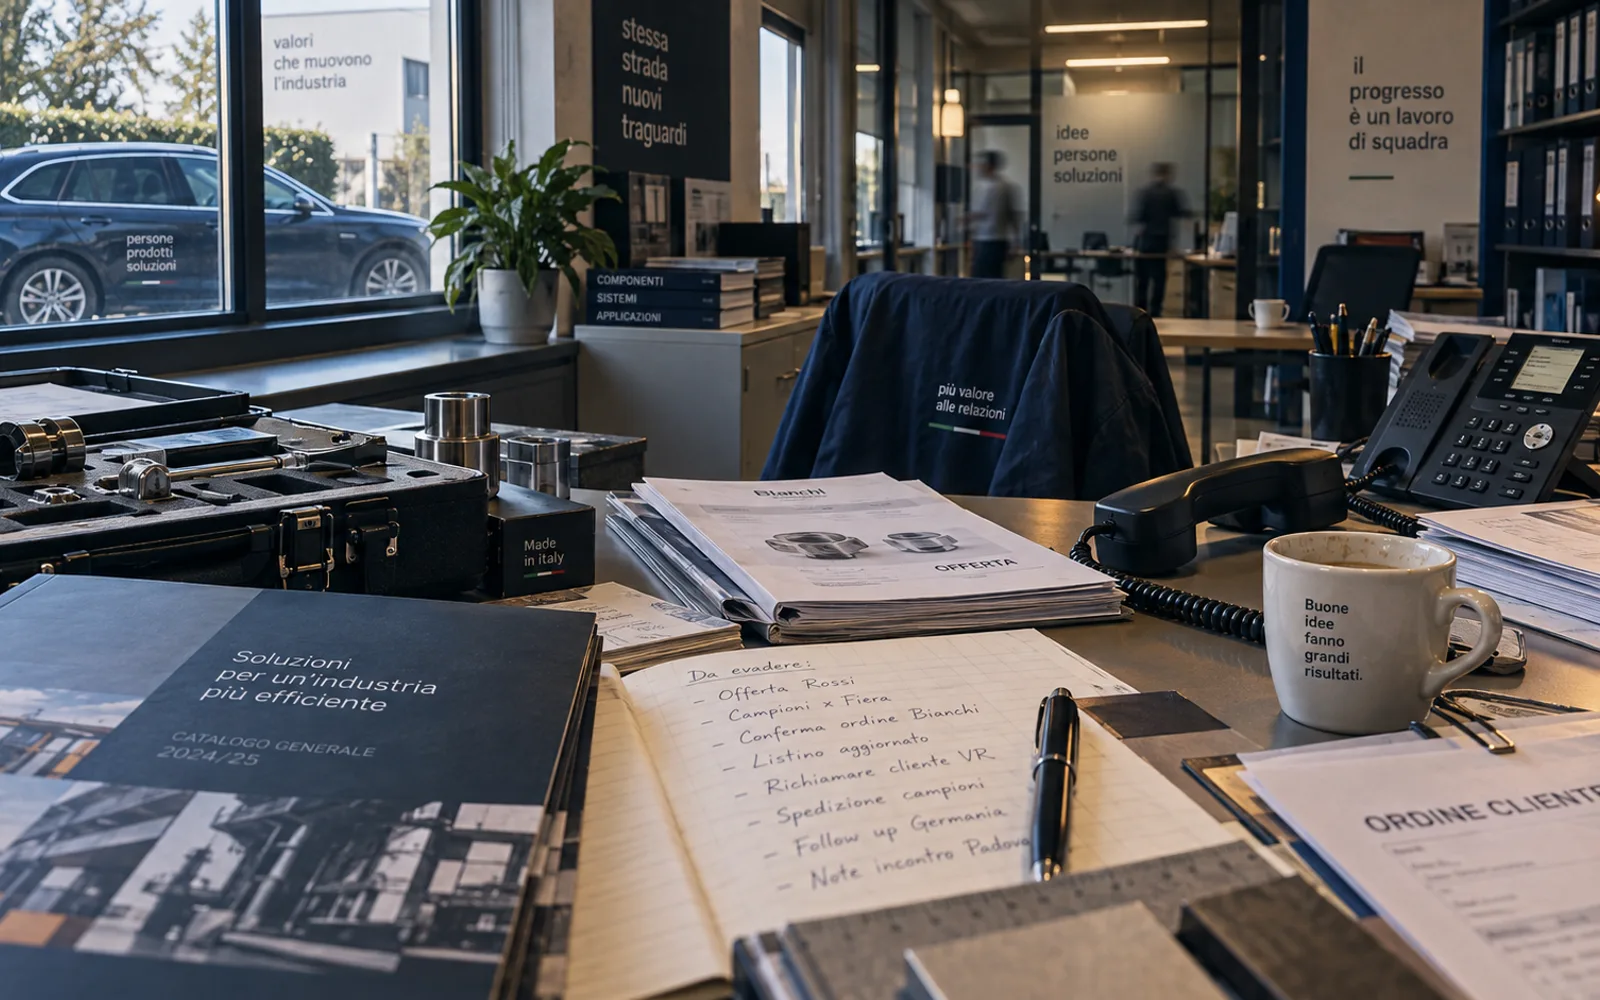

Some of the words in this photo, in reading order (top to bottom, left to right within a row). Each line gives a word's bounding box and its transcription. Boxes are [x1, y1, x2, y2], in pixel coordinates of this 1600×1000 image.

[273, 33, 314, 49] valori
[621, 17, 669, 52] stessa
[273, 55, 300, 71] che
[303, 53, 372, 69] muovono
[621, 50, 668, 82] strada
[1353, 56, 1364, 74] il
[273, 73, 347, 91] l'industria
[621, 84, 662, 111] nuovi
[1349, 85, 1444, 104] progresso
[1349, 107, 1360, 125] è
[1367, 110, 1390, 125] un
[1396, 107, 1454, 125] lavoro
[621, 114, 687, 147] traguardi
[1056, 125, 1089, 140] idee
[1349, 132, 1366, 150] di
[1372, 132, 1449, 154] squadra
[1054, 148, 1117, 165] persone
[1053, 168, 1123, 183] soluzioni
[126, 234, 174, 247] persone
[126, 246, 173, 261] prodotti
[126, 259, 176, 272] soluzioni
[596, 275, 664, 286] COMPONENTI
[596, 293, 637, 304] SISTEMI
[596, 311, 662, 322] APPLICAZIONI
[959, 386, 994, 401] valore
[936, 399, 955, 413] alle
[958, 402, 1006, 420] relazioni
[524, 538, 556, 551] Made
[524, 554, 534, 566] in
[538, 551, 565, 566] italy
[934, 558, 1018, 572] OFFERTA
[1305, 599, 1349, 615] Buone
[1305, 615, 1334, 630] idee
[1304, 632, 1345, 648] fanno
[232, 650, 352, 670] Soluzioni
[1304, 649, 1350, 667] grandi
[687, 669, 717, 682] Da
[732, 660, 811, 674] evadere:
[1304, 665, 1363, 681] risultati.
[215, 669, 266, 682] per
[272, 673, 437, 694] un'industria
[718, 683, 789, 702] Offerta
[802, 676, 855, 690] Rossi
[200, 687, 248, 700] più
[255, 691, 387, 712] efficiente
[728, 702, 811, 722] Campioni
[841, 694, 892, 706] Fiera
[738, 722, 826, 746] Conferma
[840, 714, 899, 729] ordine
[907, 703, 981, 720] Bianchi
[171, 731, 271, 749] CATALOGO
[275, 740, 376, 757] GENERALE
[752, 747, 825, 769] Listino
[839, 732, 930, 758] aggiornato
[156, 745, 260, 766] 2024/25
[765, 767, 876, 794] Richiamare
[889, 755, 951, 774] cliente
[957, 747, 996, 765] VR
[776, 795, 885, 827] Spedizione
[903, 778, 984, 801] campioni
[1364, 803, 1487, 834] ORDINE
[794, 831, 860, 858] Follow
[873, 827, 899, 843] up
[910, 806, 1007, 832] Germania
[810, 867, 864, 891] Note
[875, 846, 955, 875] incontro
